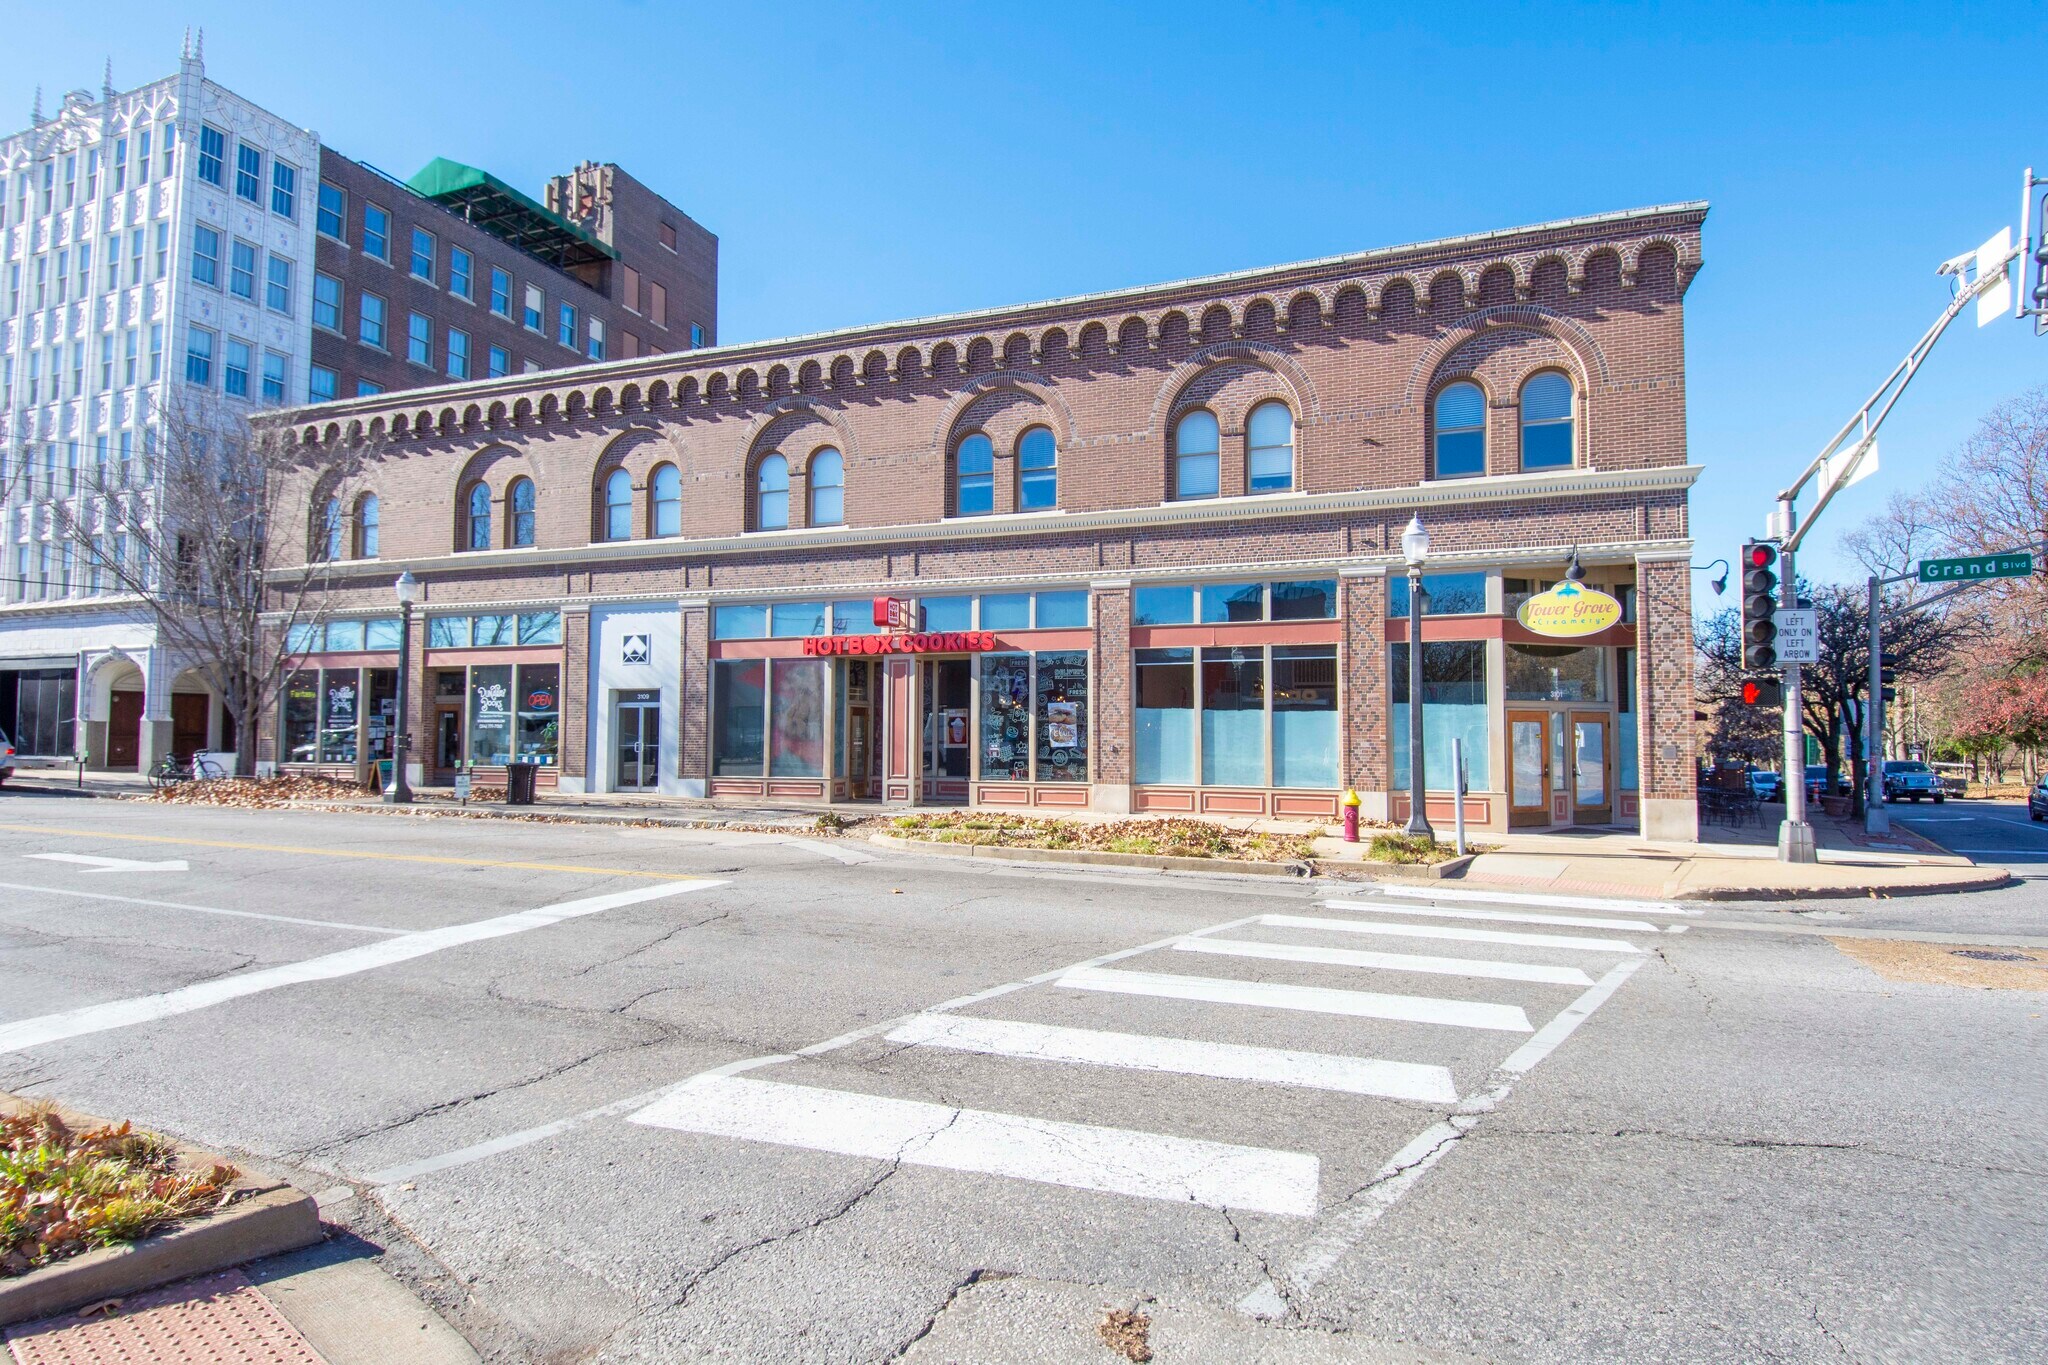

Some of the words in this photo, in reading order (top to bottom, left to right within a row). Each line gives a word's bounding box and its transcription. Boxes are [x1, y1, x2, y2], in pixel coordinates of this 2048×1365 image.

[1926, 560, 1996, 577] Grand
[2002, 561, 2027, 570] Blvd
[1527, 604, 1570, 620] Tower
[1574, 601, 1614, 617] Grove
[1786, 617, 1804, 626] LEFT
[1779, 628, 1798, 637] ONLY
[1801, 628, 1812, 637] ON
[899, 631, 994, 653] COOKIES
[1787, 639, 1804, 648] LEFT
[1784, 650, 1810, 659] ARROW
[528, 694, 552, 706] OPEN
